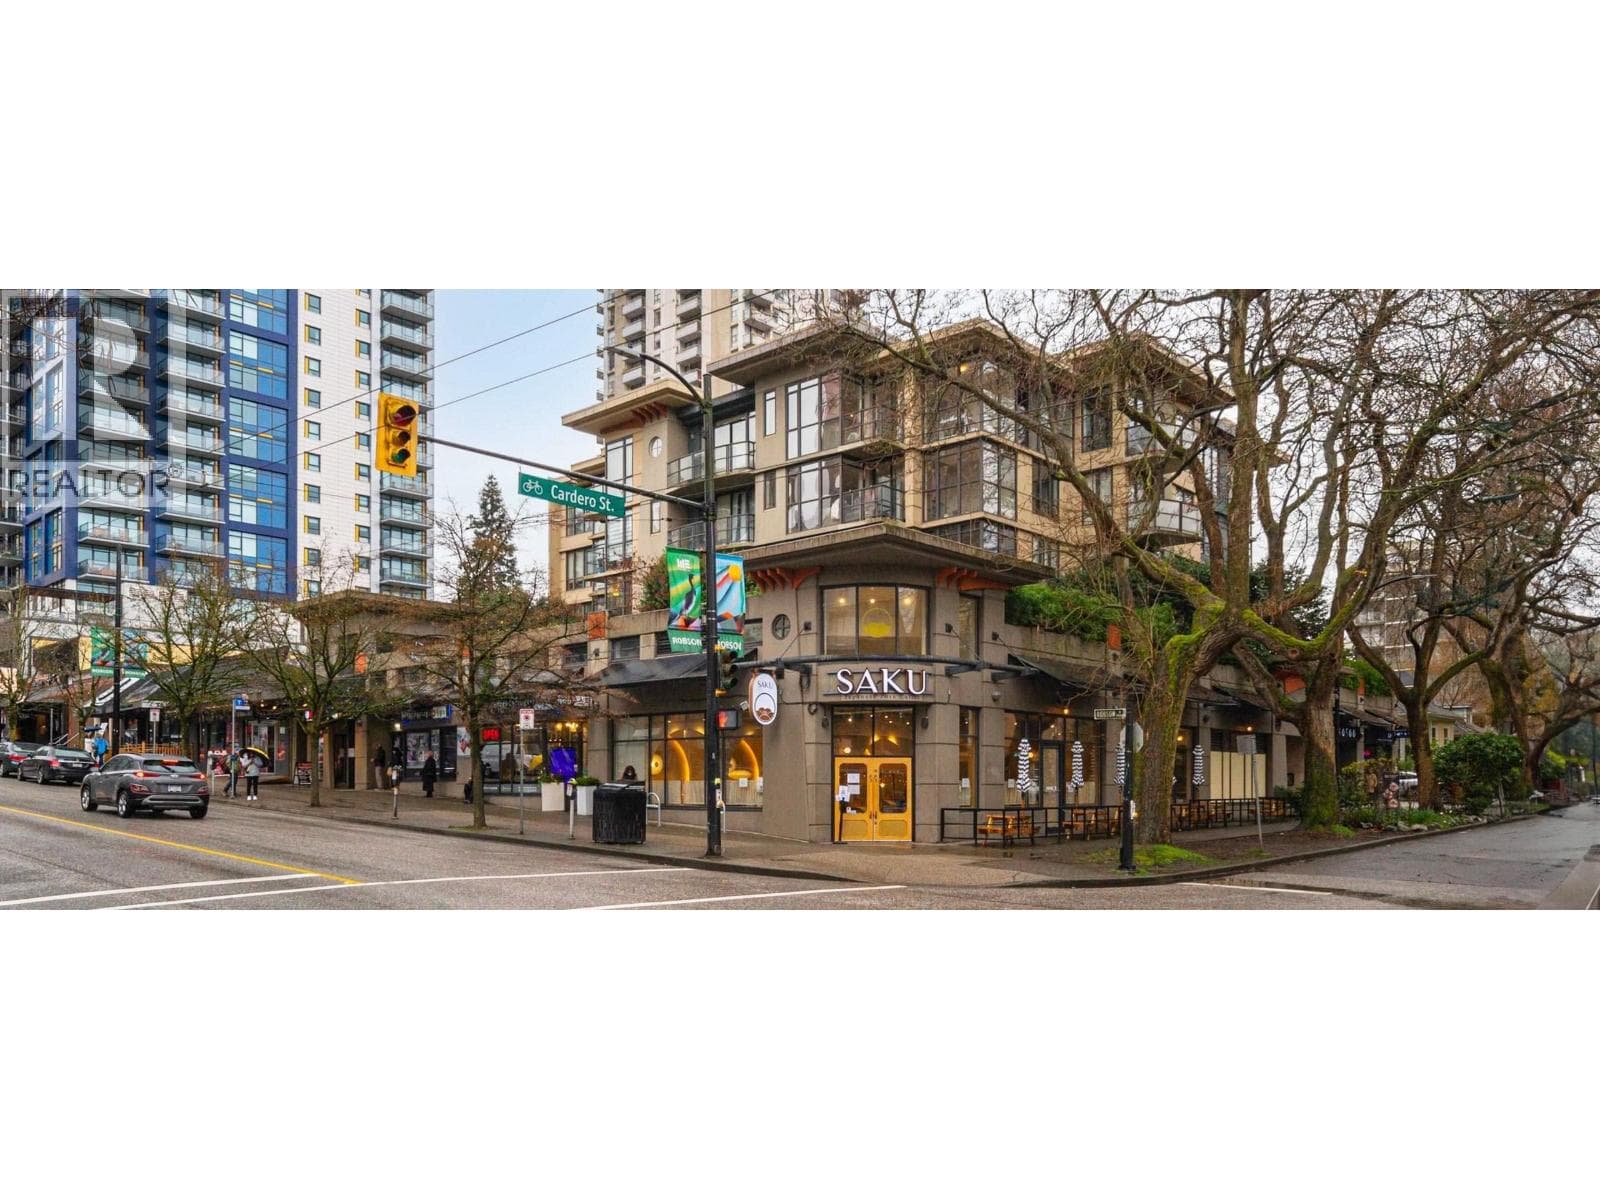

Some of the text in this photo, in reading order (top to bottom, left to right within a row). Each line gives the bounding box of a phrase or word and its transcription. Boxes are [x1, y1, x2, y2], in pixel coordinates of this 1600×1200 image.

[550, 484, 615, 512] Cardero St.
[672, 637, 702, 647] ROBSON
[758, 680, 773, 689] SAKU
[836, 667, 926, 695] SAKU
